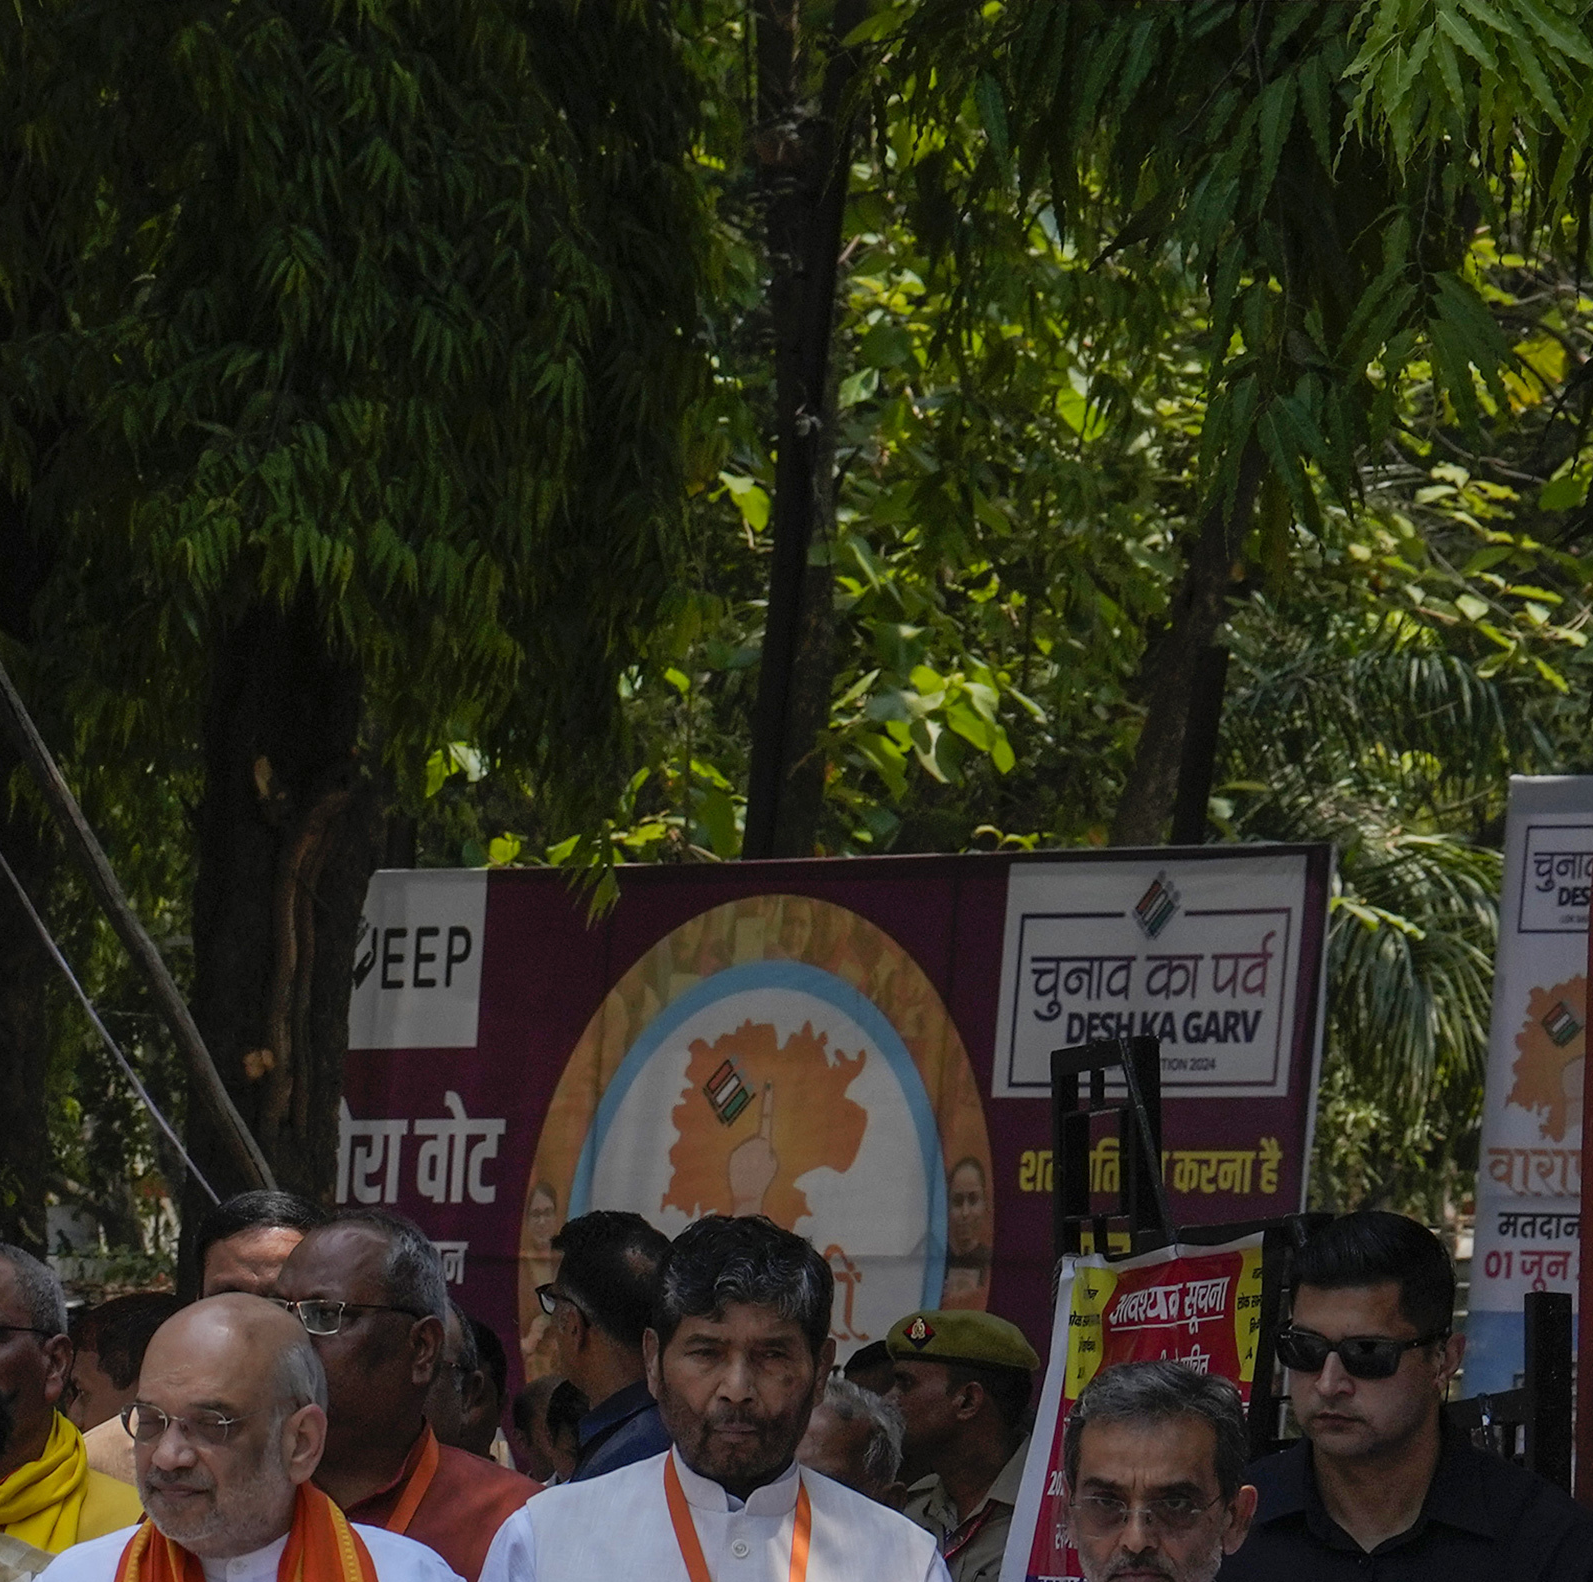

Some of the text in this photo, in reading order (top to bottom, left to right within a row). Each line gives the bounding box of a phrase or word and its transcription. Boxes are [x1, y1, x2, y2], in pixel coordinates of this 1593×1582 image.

[1557, 886, 1590, 906] DES
[1030, 930, 1277, 1021] चुनाव का पर्व
[1066, 1010, 1263, 1044] DESH KA GARV
[414, 1090, 507, 1204] वोट
[1170, 1150, 1257, 1194] करना
[1259, 1137, 1283, 1194] है
[1484, 1251, 1573, 1292] 01 जून
[1184, 1276, 1231, 1335] सूचना
